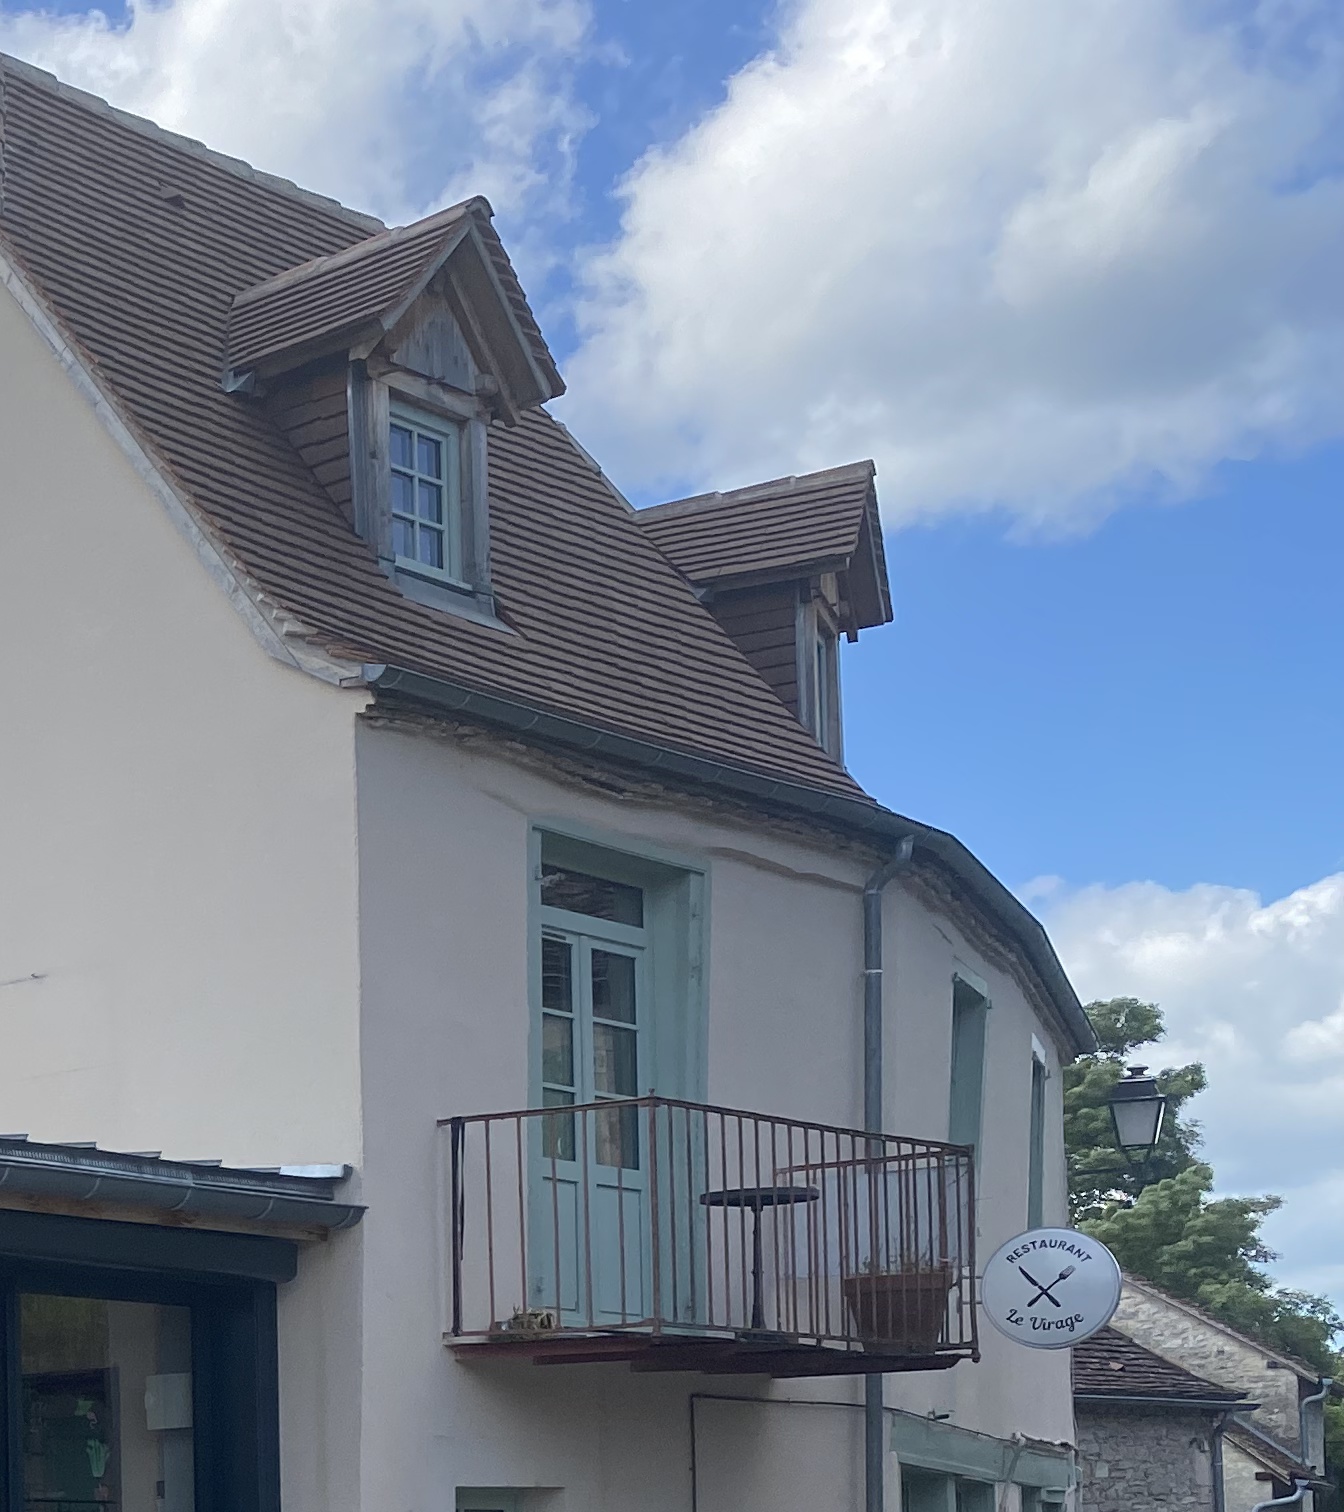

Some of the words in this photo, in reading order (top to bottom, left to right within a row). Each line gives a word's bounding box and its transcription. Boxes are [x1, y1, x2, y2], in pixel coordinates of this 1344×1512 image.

[1006, 1238, 1092, 1263] RESTAURANT
[1005, 1308, 1024, 1326] Le
[1029, 1313, 1084, 1332] Virage
